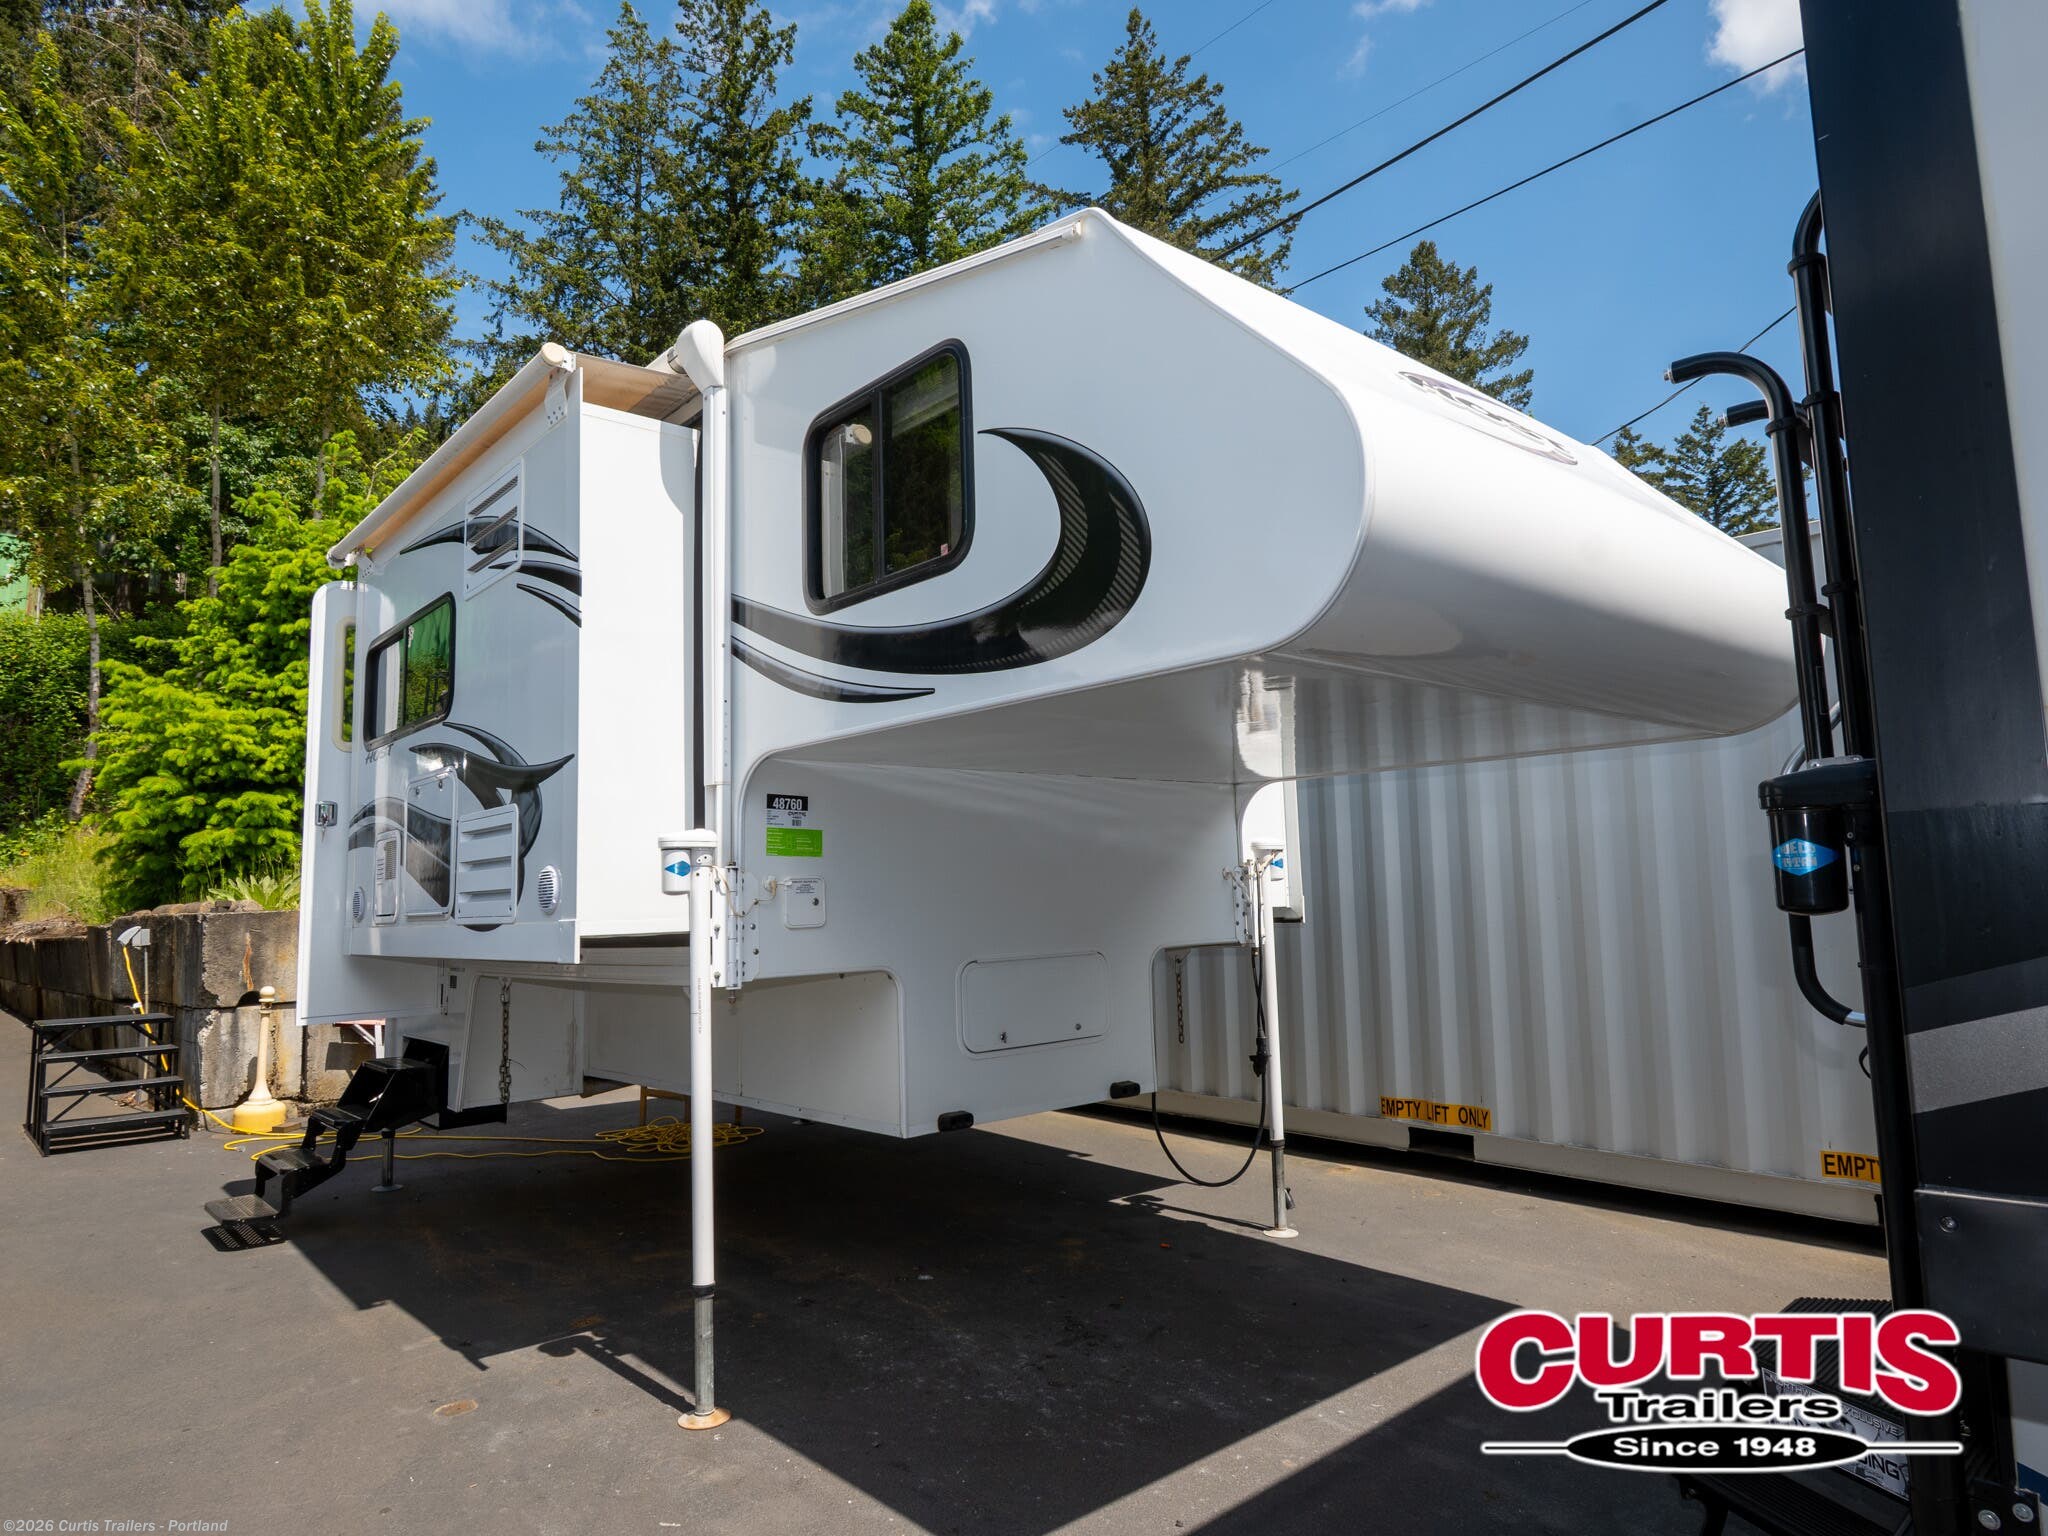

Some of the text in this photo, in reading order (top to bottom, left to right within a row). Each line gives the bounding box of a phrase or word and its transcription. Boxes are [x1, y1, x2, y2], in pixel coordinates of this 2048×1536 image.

[772, 797, 803, 810] 48760
[1381, 1099, 1488, 1128] EMPTY LIFT ONLY
